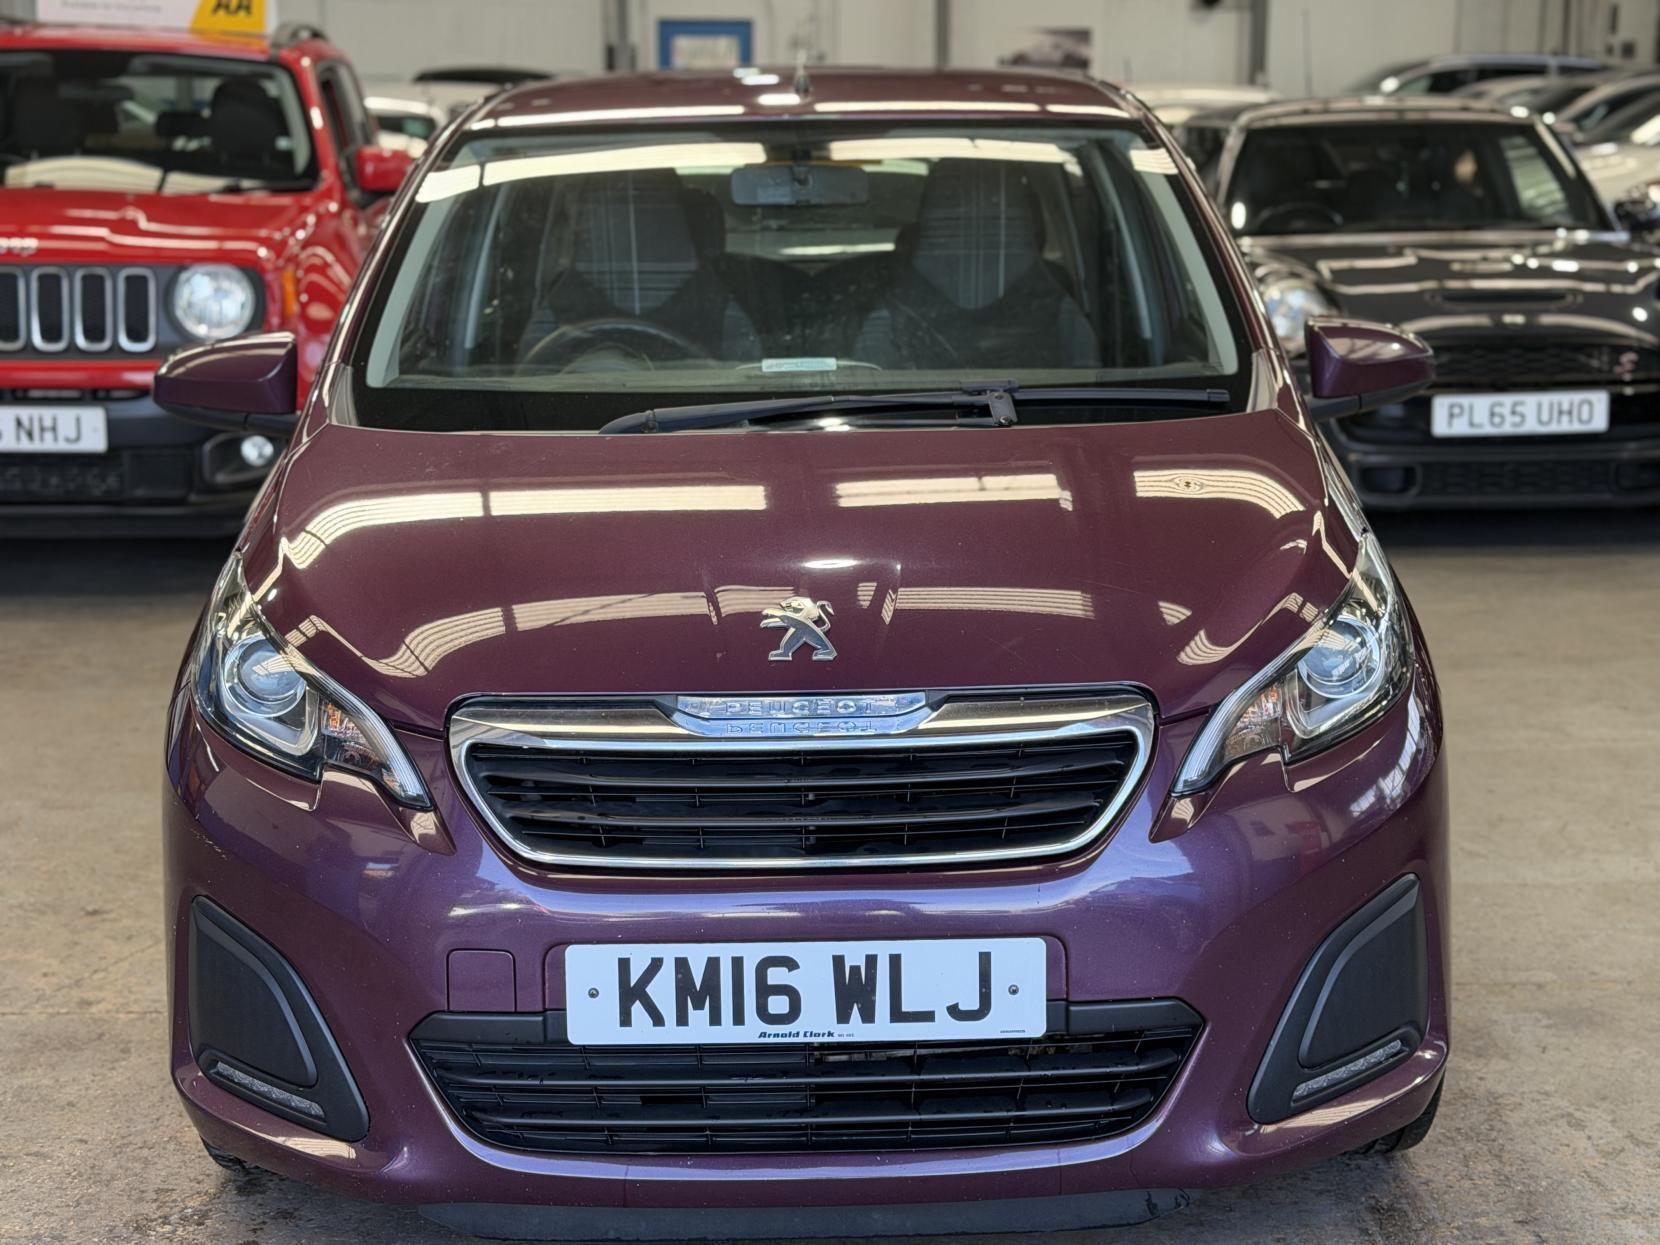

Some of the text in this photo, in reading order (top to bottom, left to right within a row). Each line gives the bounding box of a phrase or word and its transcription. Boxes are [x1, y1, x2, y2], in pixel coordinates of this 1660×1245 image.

[14, 413, 82, 444] NHJ
[1448, 398, 1595, 429] PL65 UHO
[725, 700, 875, 716] PEUGEOT
[618, 951, 992, 1028] KM16 WLJ
[758, 1030, 800, 1039] Arnold
[802, 1030, 835, 1039] Clark
